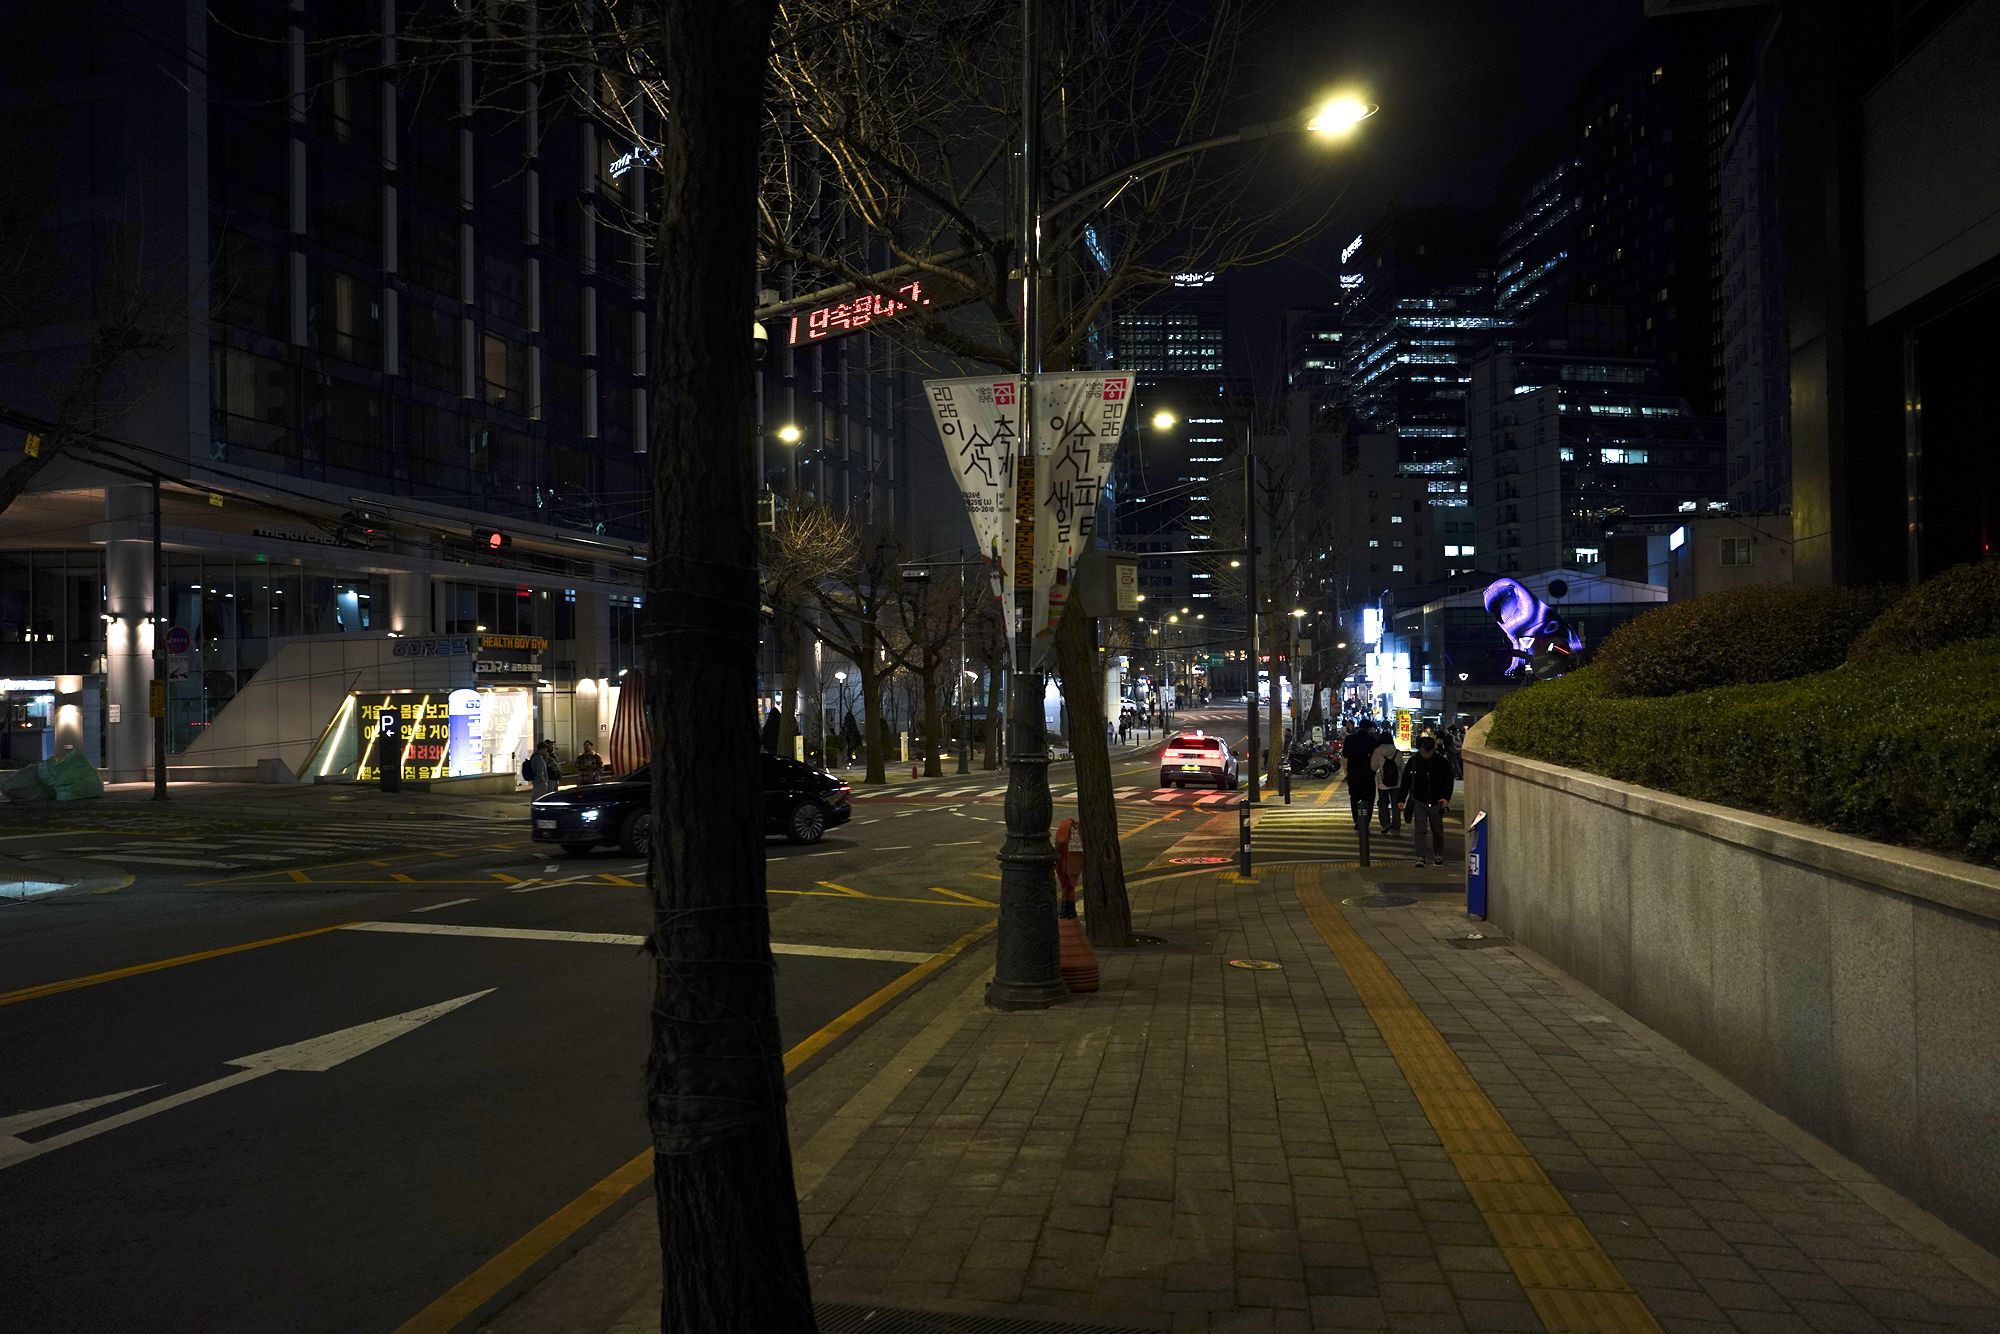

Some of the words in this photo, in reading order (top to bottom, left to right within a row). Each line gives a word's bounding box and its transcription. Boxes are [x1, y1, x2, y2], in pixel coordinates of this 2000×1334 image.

[483, 636, 514, 648] HEALTH
[514, 638, 531, 649] BOY
[531, 639, 549, 650] GYM
[381, 715, 395, 732] P
